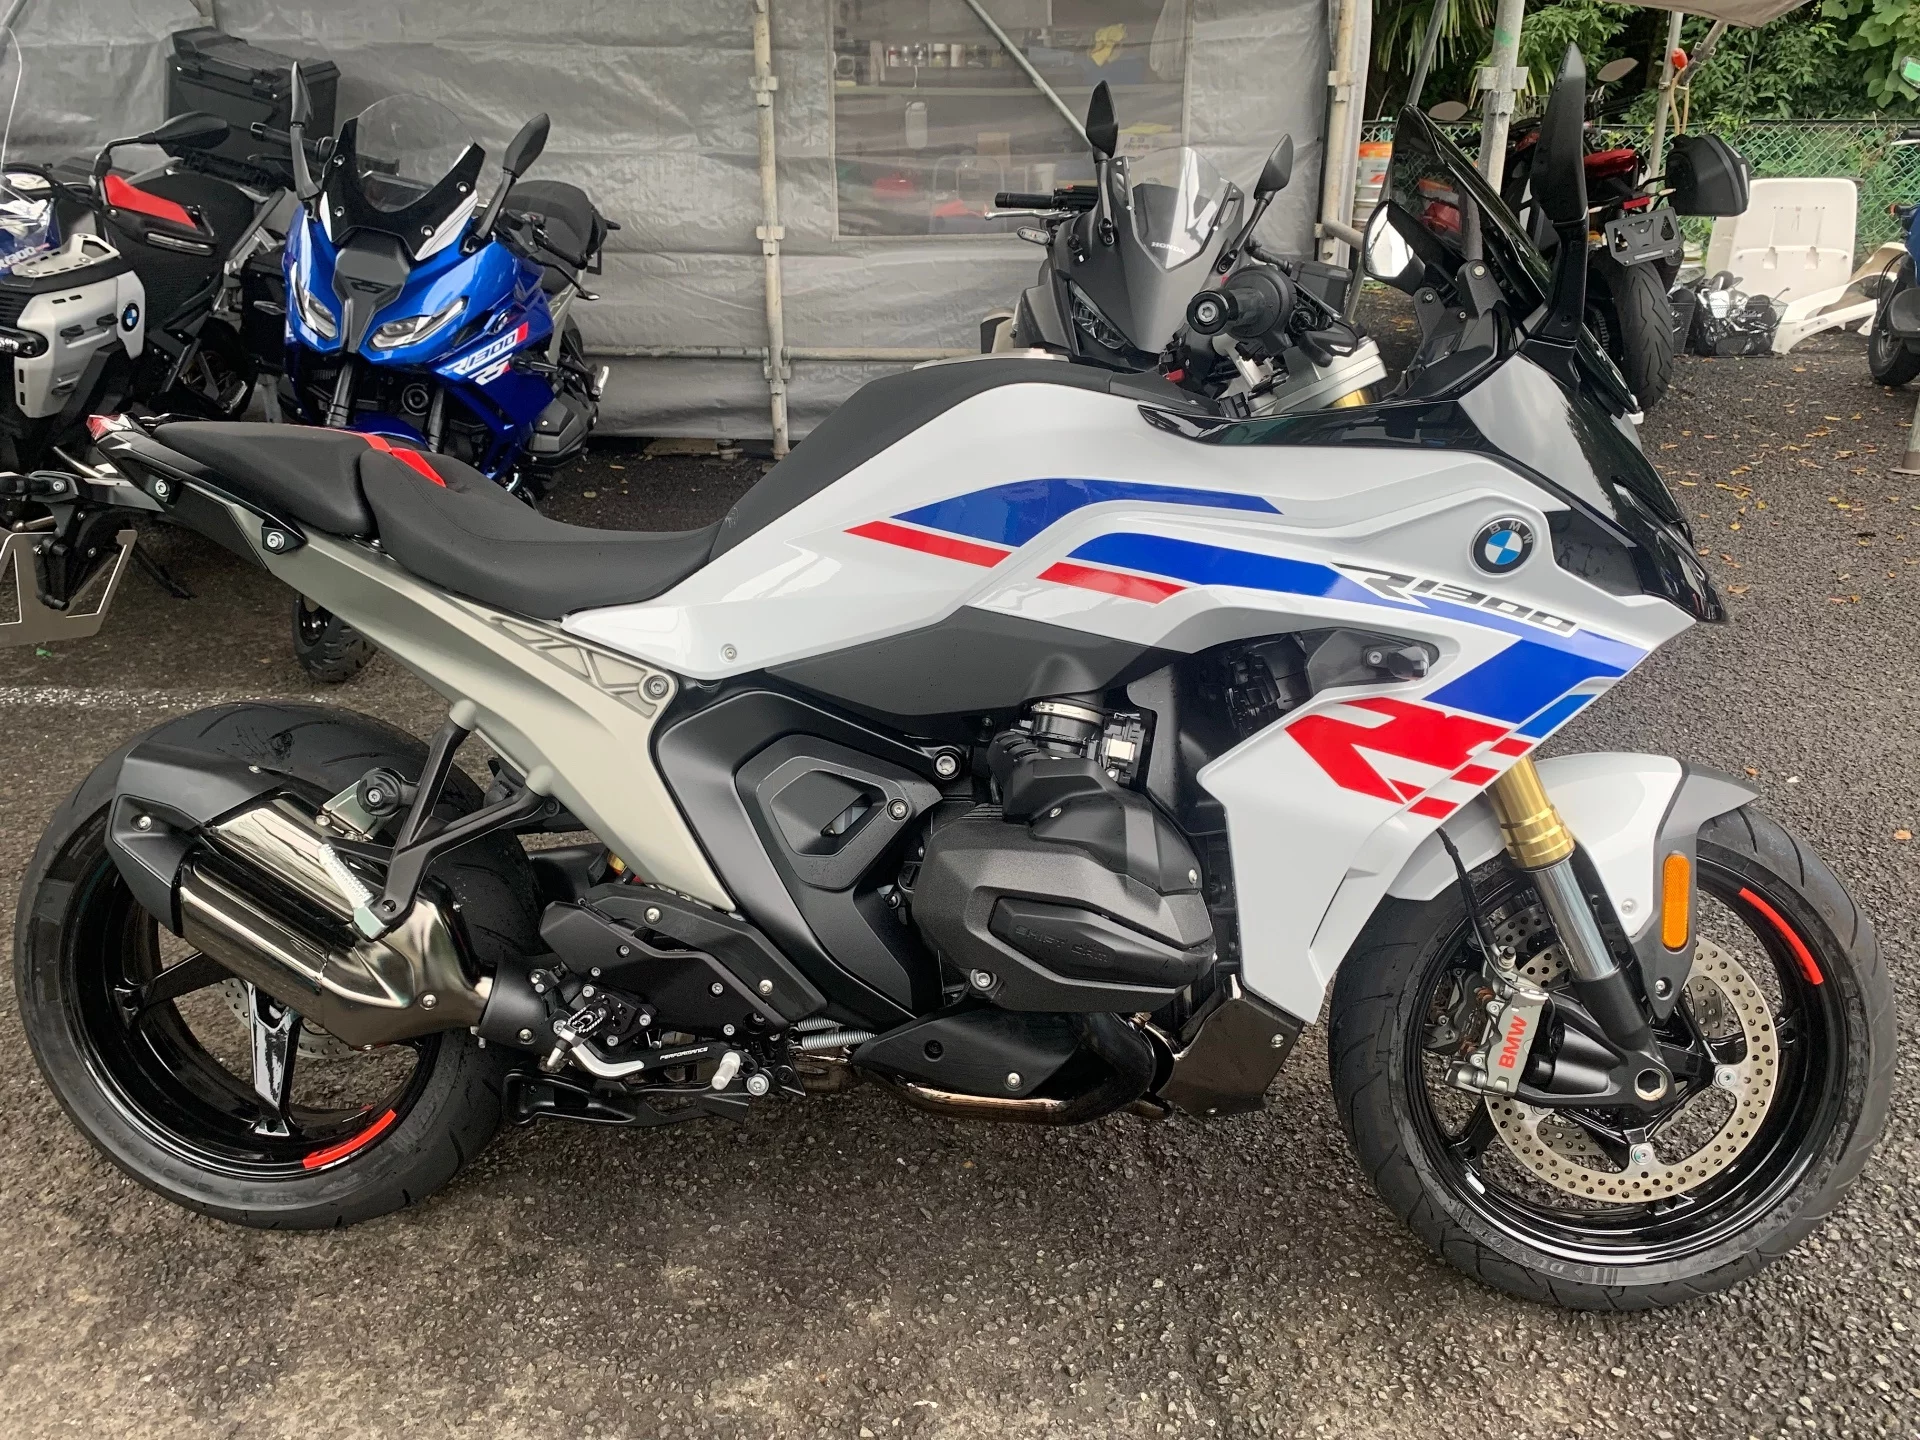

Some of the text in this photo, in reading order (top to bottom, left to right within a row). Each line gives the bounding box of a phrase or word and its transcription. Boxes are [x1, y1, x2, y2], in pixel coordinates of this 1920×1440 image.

[1151, 241, 1186, 255] HONDA
[1488, 520, 1533, 545] BMW
[1498, 1015, 1527, 1069] BMW
[659, 1046, 709, 1060] PERFORMANCE
